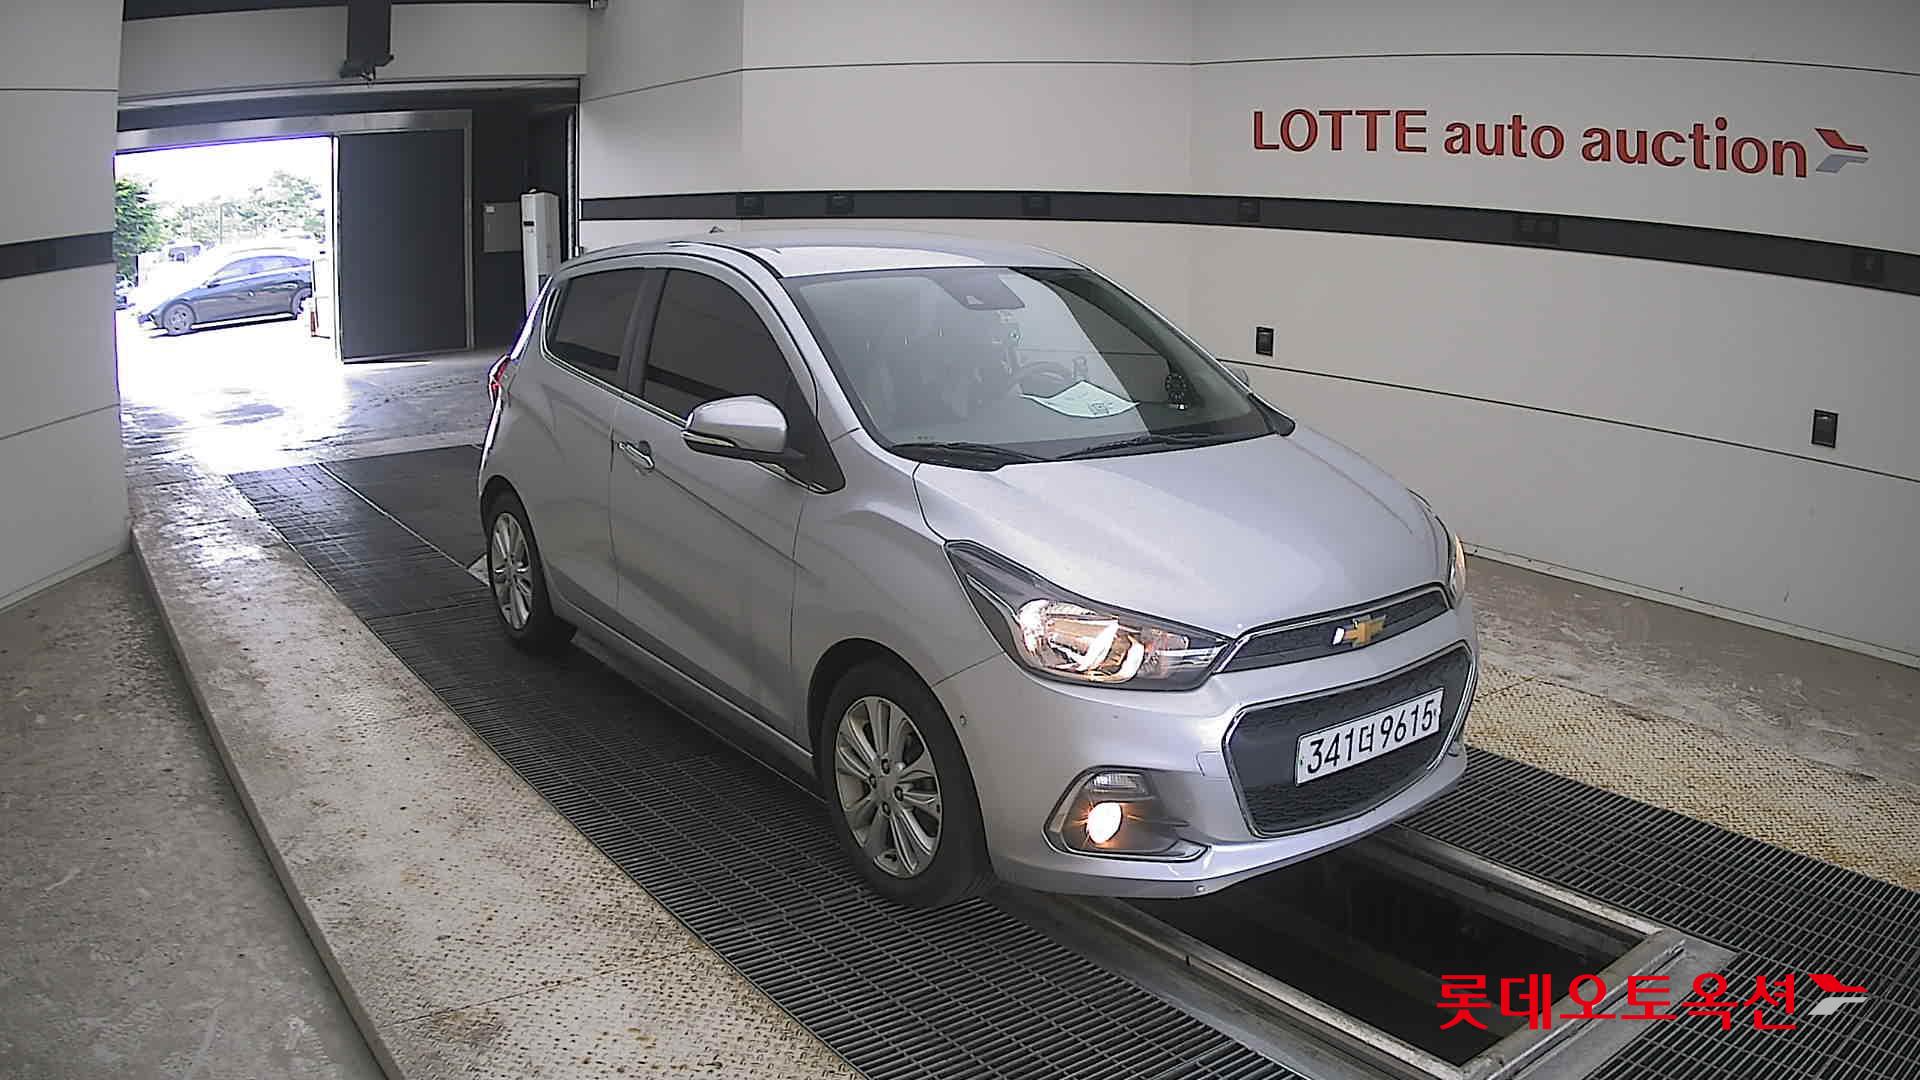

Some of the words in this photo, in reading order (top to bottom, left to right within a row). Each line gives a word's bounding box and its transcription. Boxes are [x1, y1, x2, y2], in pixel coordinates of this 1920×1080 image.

[1253, 109, 1428, 153] LOTTE
[1444, 114, 1565, 160] auto
[1582, 116, 1808, 178] auction
